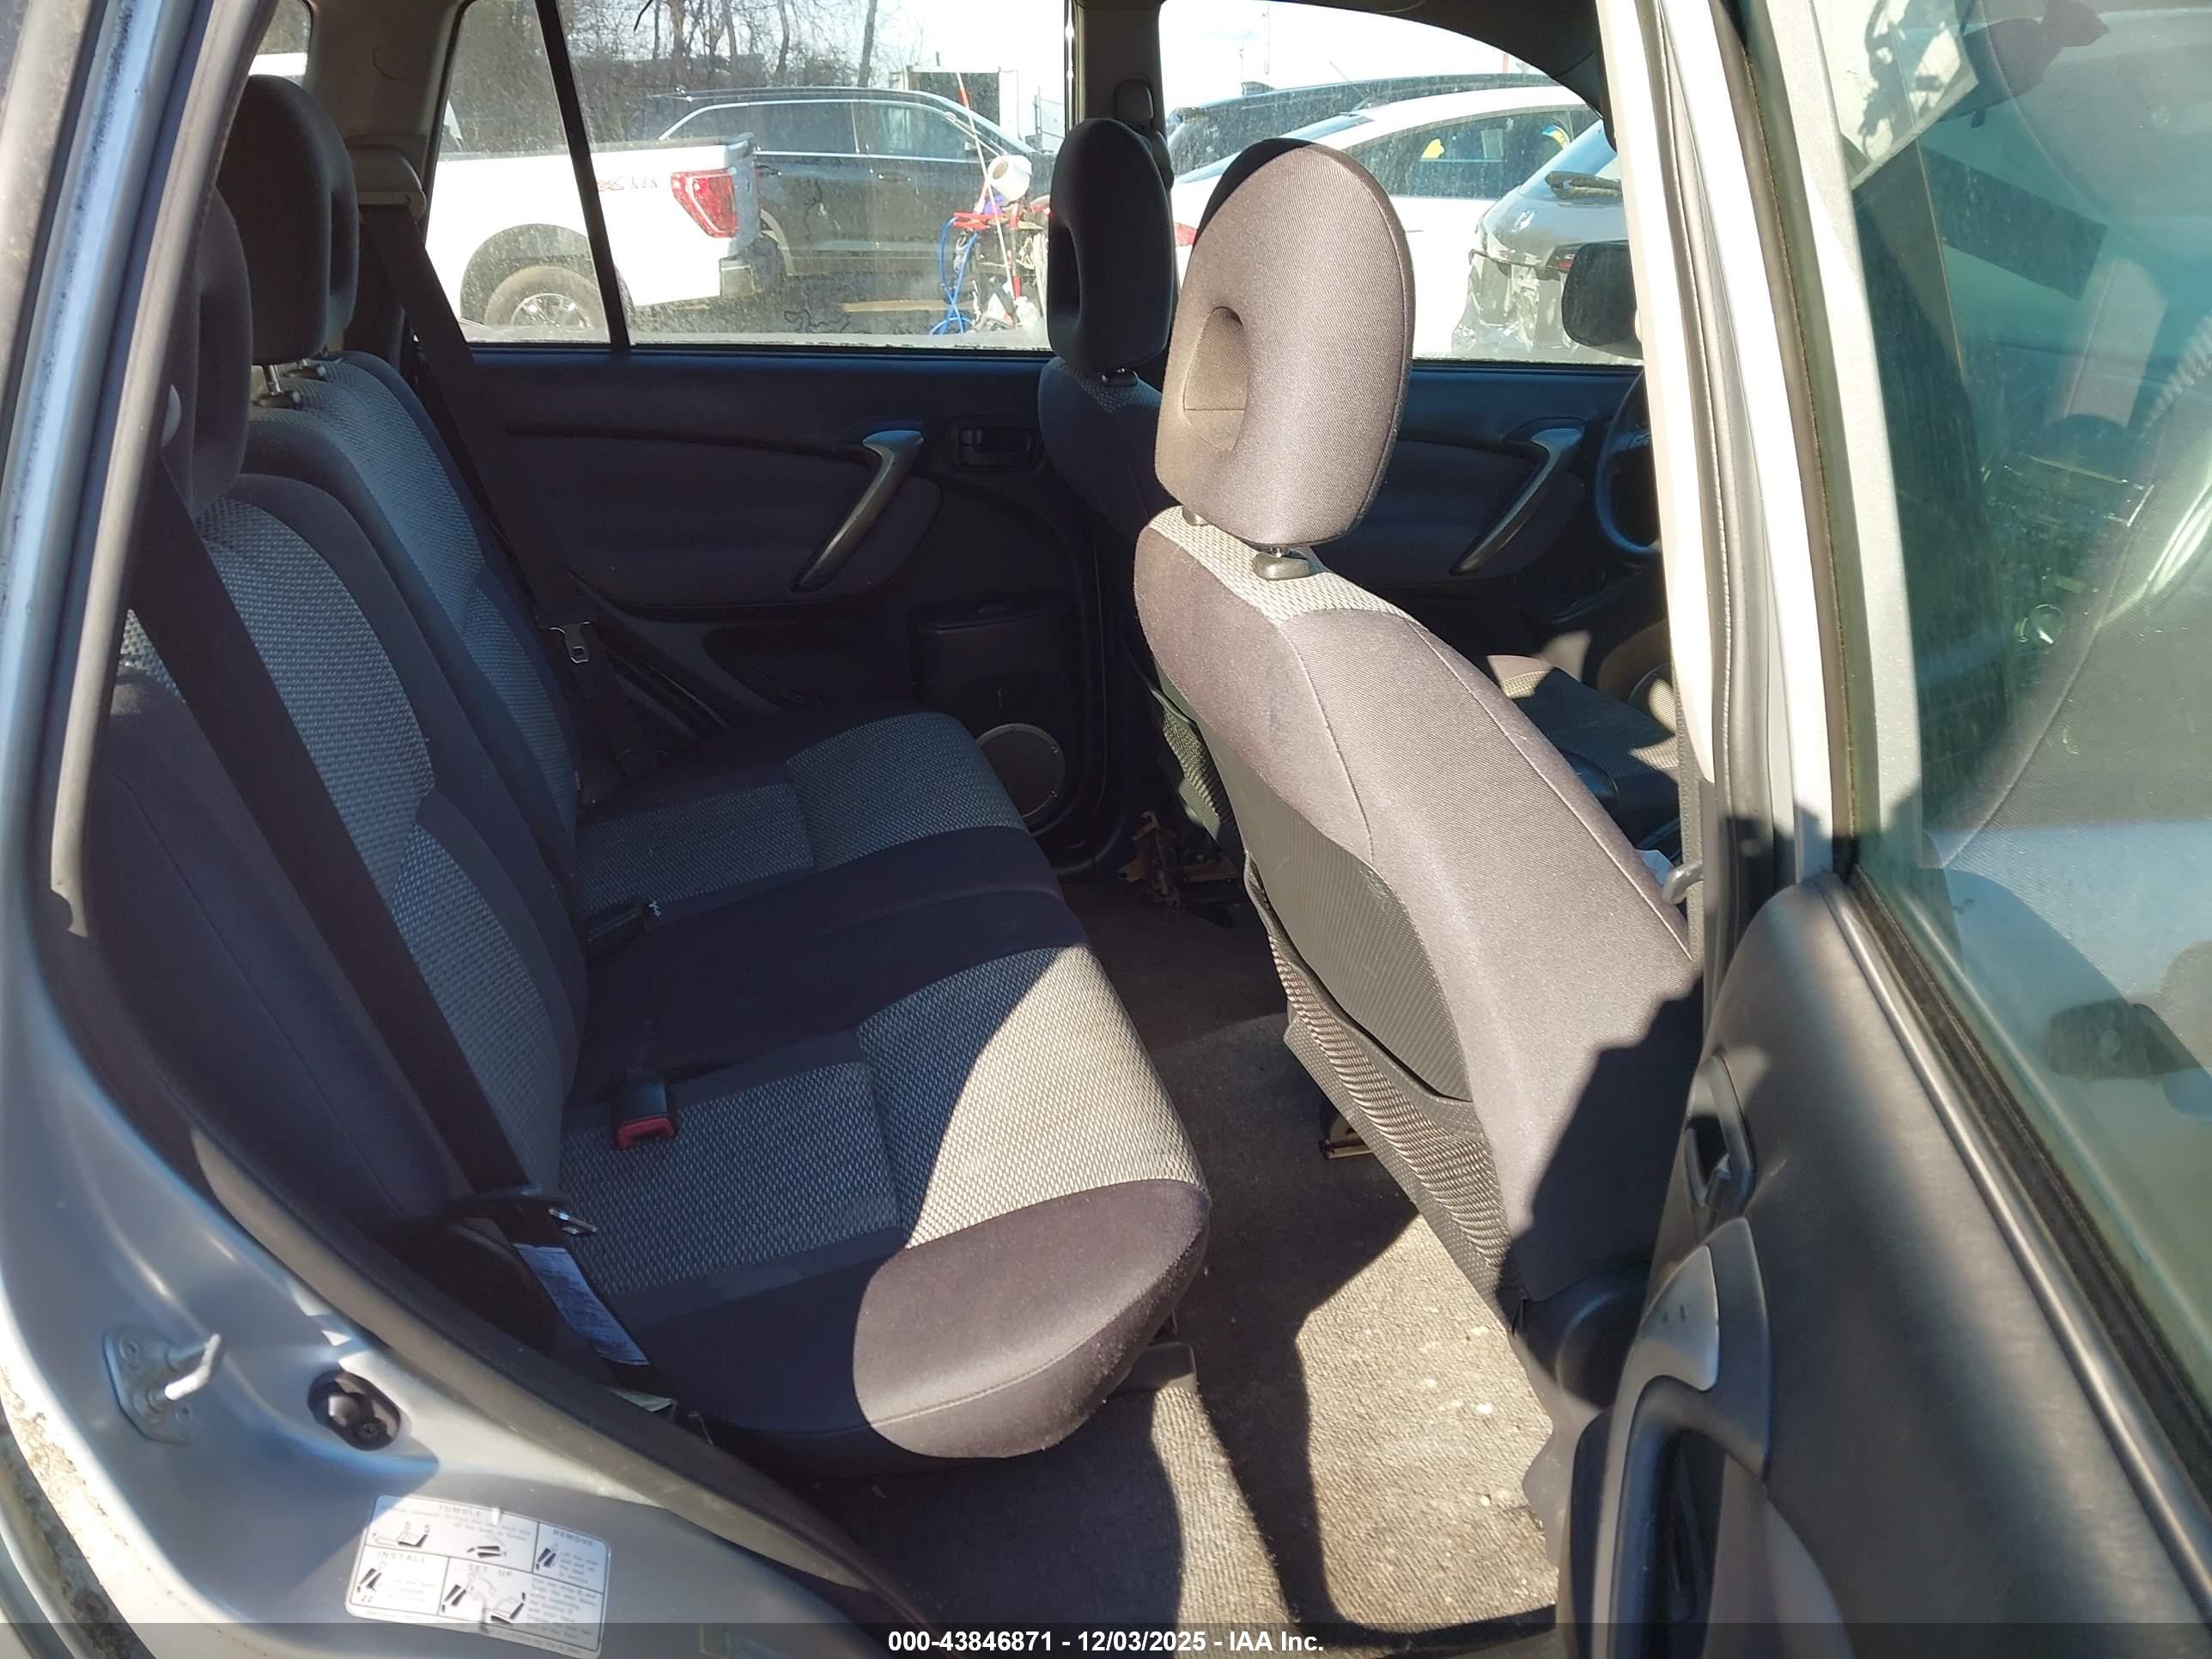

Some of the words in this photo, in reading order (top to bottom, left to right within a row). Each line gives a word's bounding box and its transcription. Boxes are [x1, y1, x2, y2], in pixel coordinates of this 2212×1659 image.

[438, 1504, 482, 1517] TUMBLE
[552, 1528, 594, 1547] REMOVE
[377, 1551, 426, 1565] INSTALL
[467, 1563, 489, 1575] SET
[497, 1569, 514, 1579] UP
